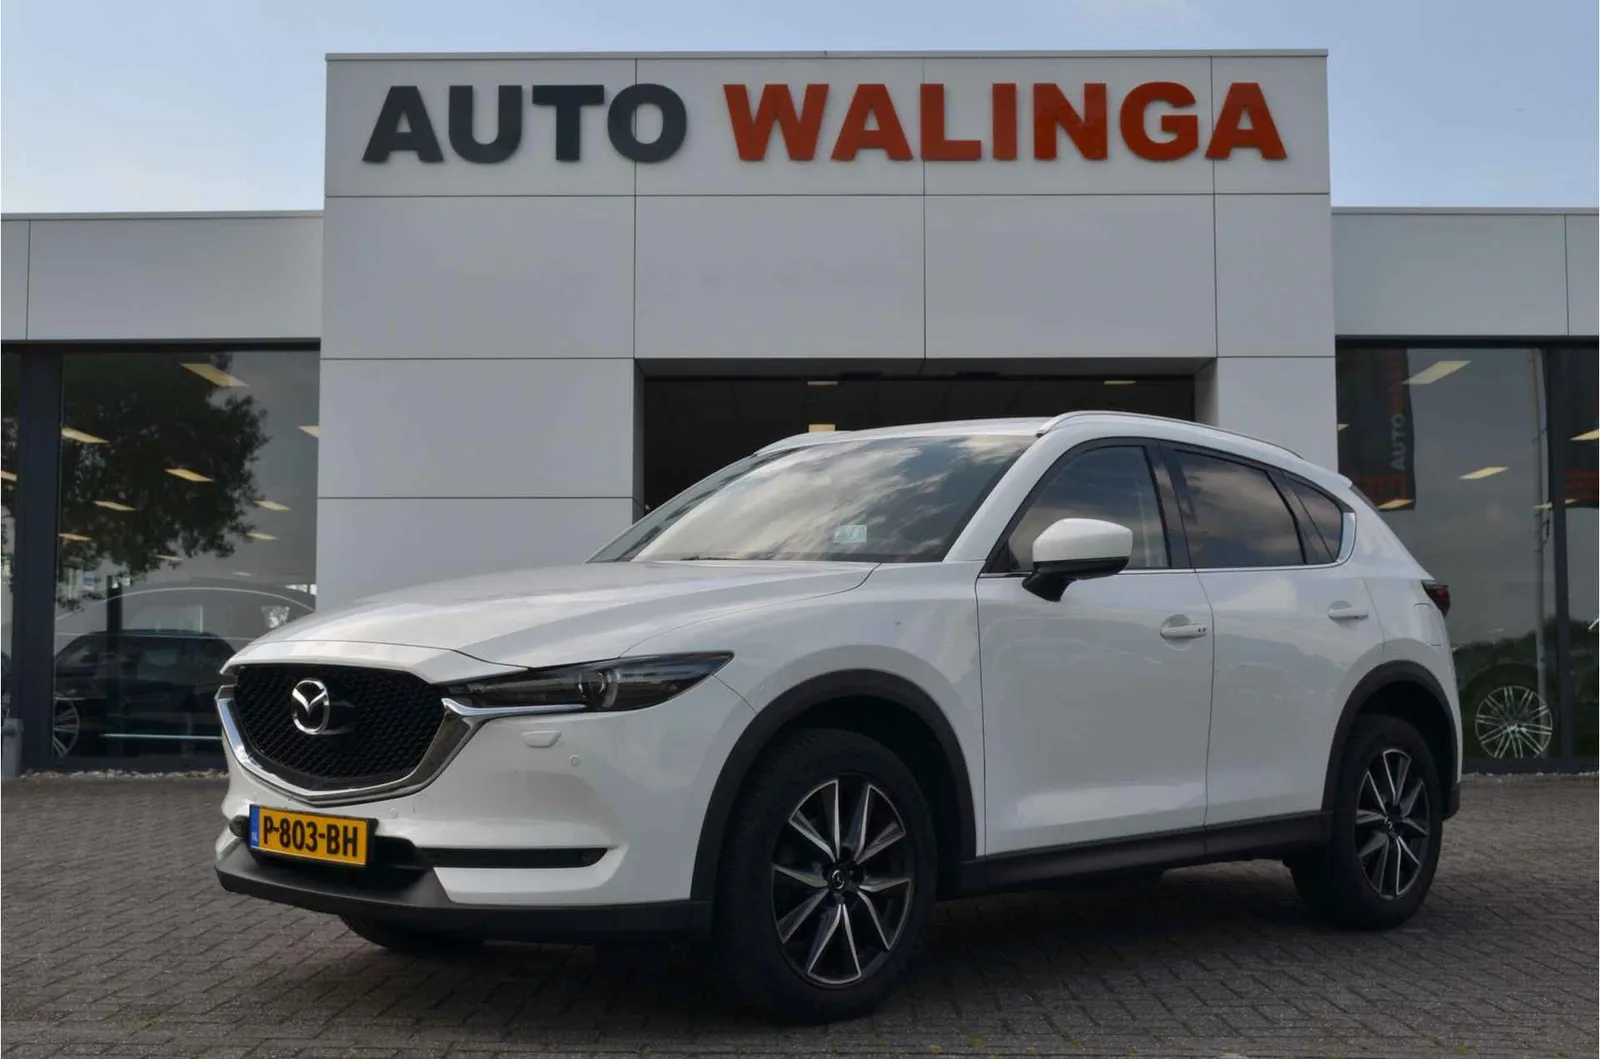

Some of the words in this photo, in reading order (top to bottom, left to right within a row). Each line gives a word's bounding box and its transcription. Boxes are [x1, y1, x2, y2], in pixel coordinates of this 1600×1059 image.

[363, 83, 687, 164] AUTO
[725, 82, 1286, 163] WALINGA
[1390, 413, 1407, 471] AUTO
[263, 815, 358, 857] P-803-BH
